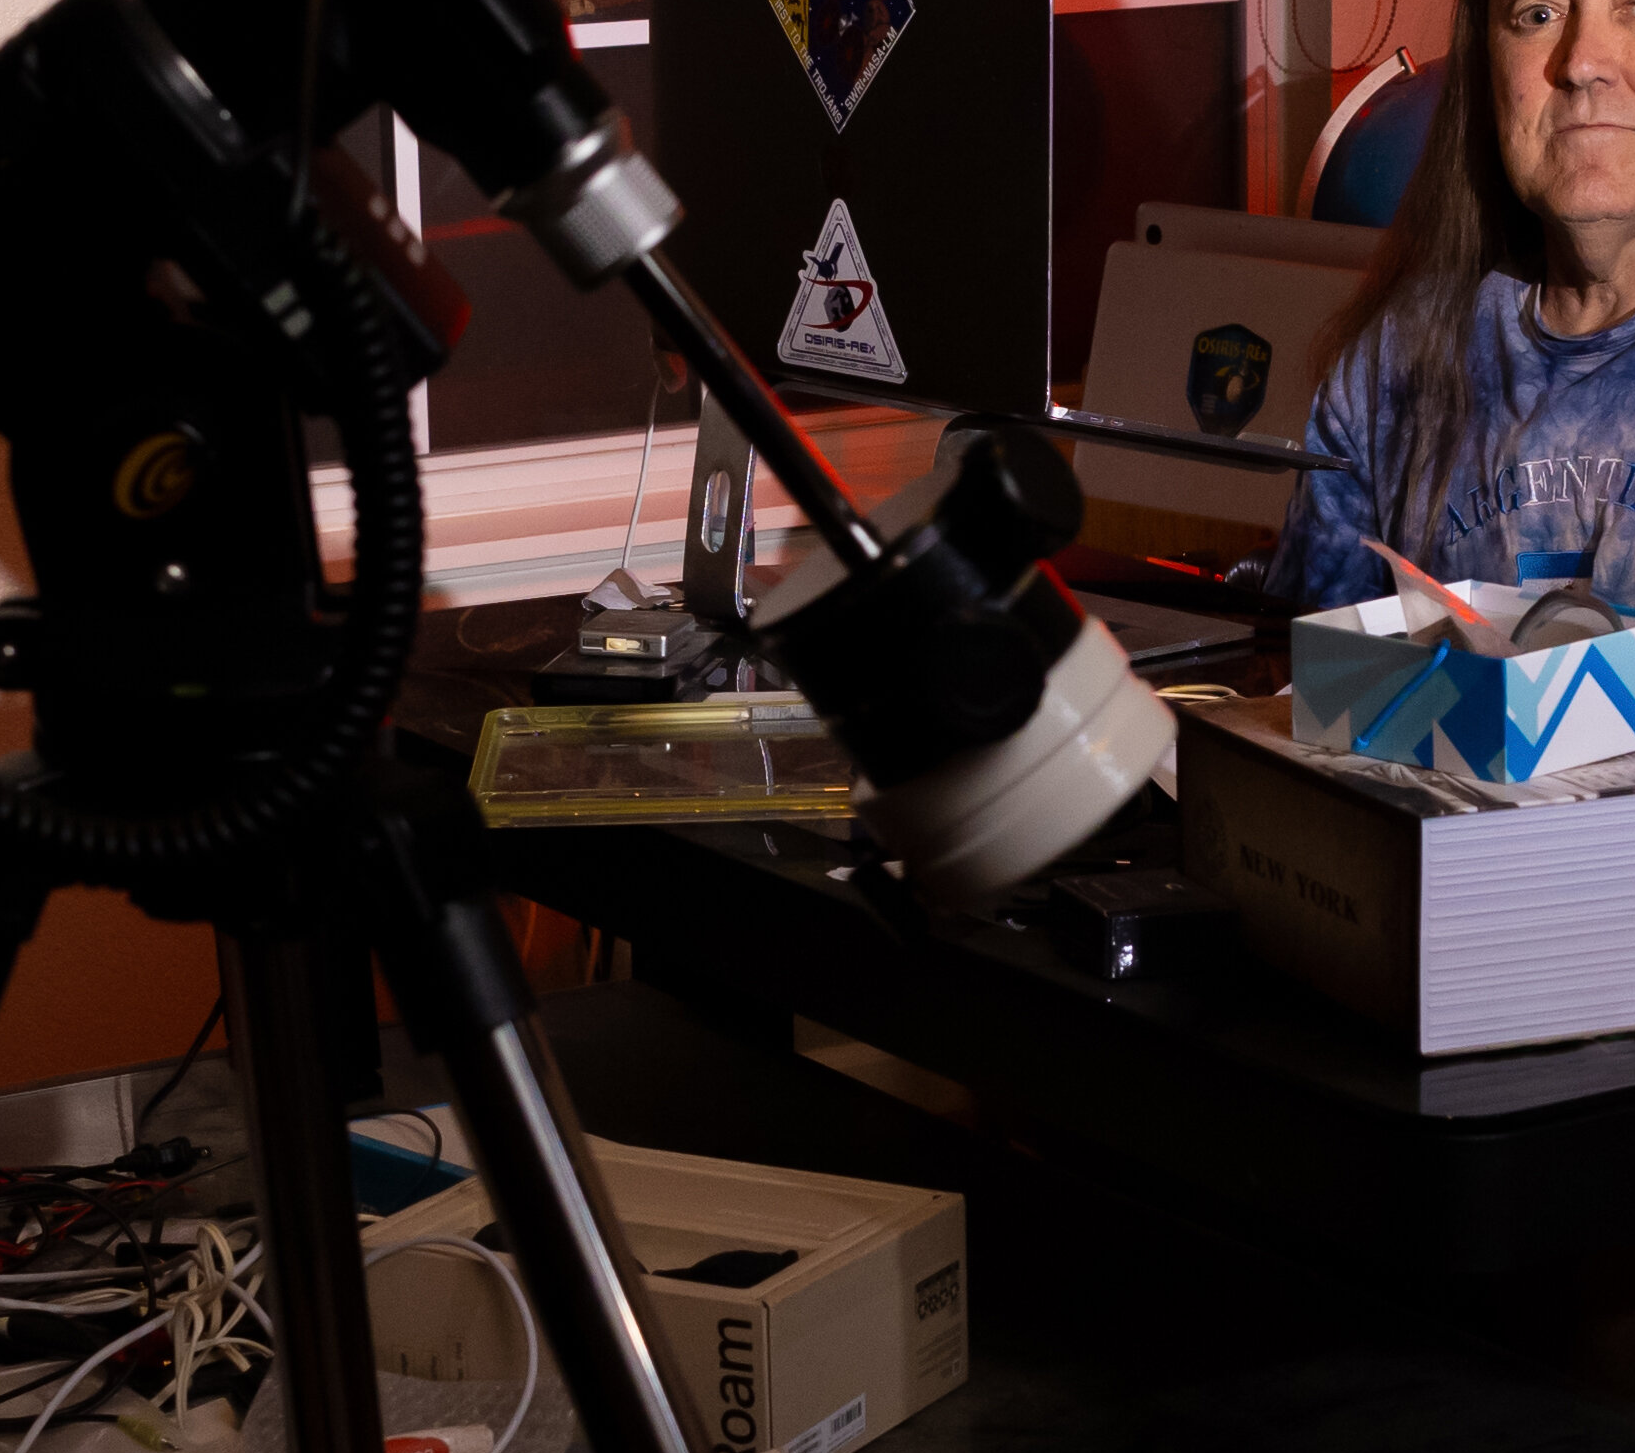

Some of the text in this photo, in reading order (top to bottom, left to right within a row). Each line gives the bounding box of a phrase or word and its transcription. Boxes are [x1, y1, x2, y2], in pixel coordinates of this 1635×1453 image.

[798, 45, 815, 70] THE
[813, 67, 844, 125] TROJANS
[1239, 844, 1360, 926] NEW YORK
